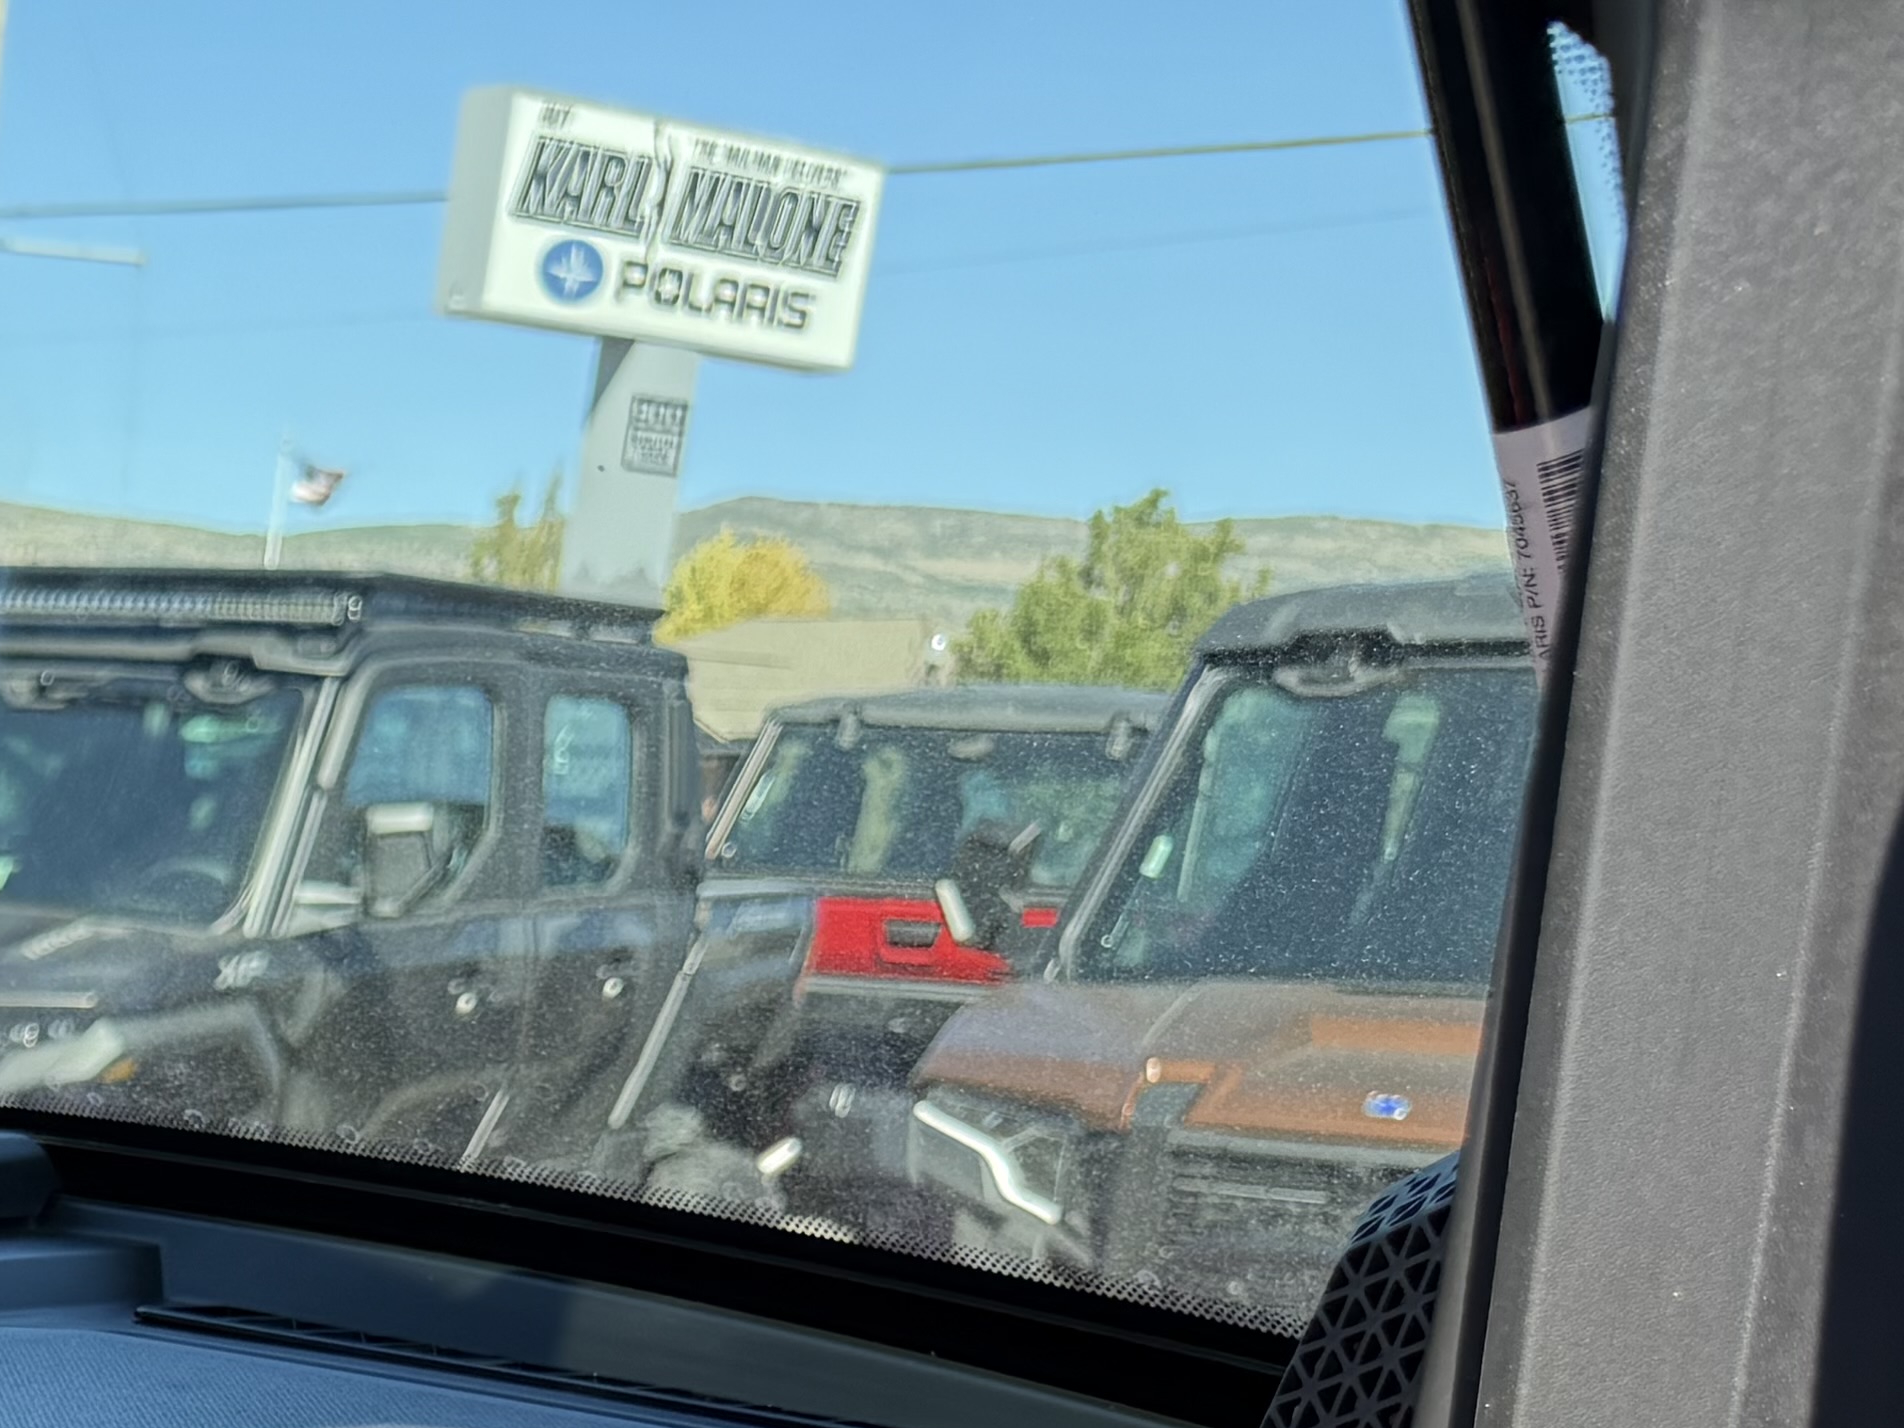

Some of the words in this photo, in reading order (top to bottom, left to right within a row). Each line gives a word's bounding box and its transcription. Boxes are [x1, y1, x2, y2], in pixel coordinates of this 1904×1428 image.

[509, 137, 652, 241] KARL
[665, 167, 860, 278] MALONE
[616, 260, 816, 330] POLARIS
